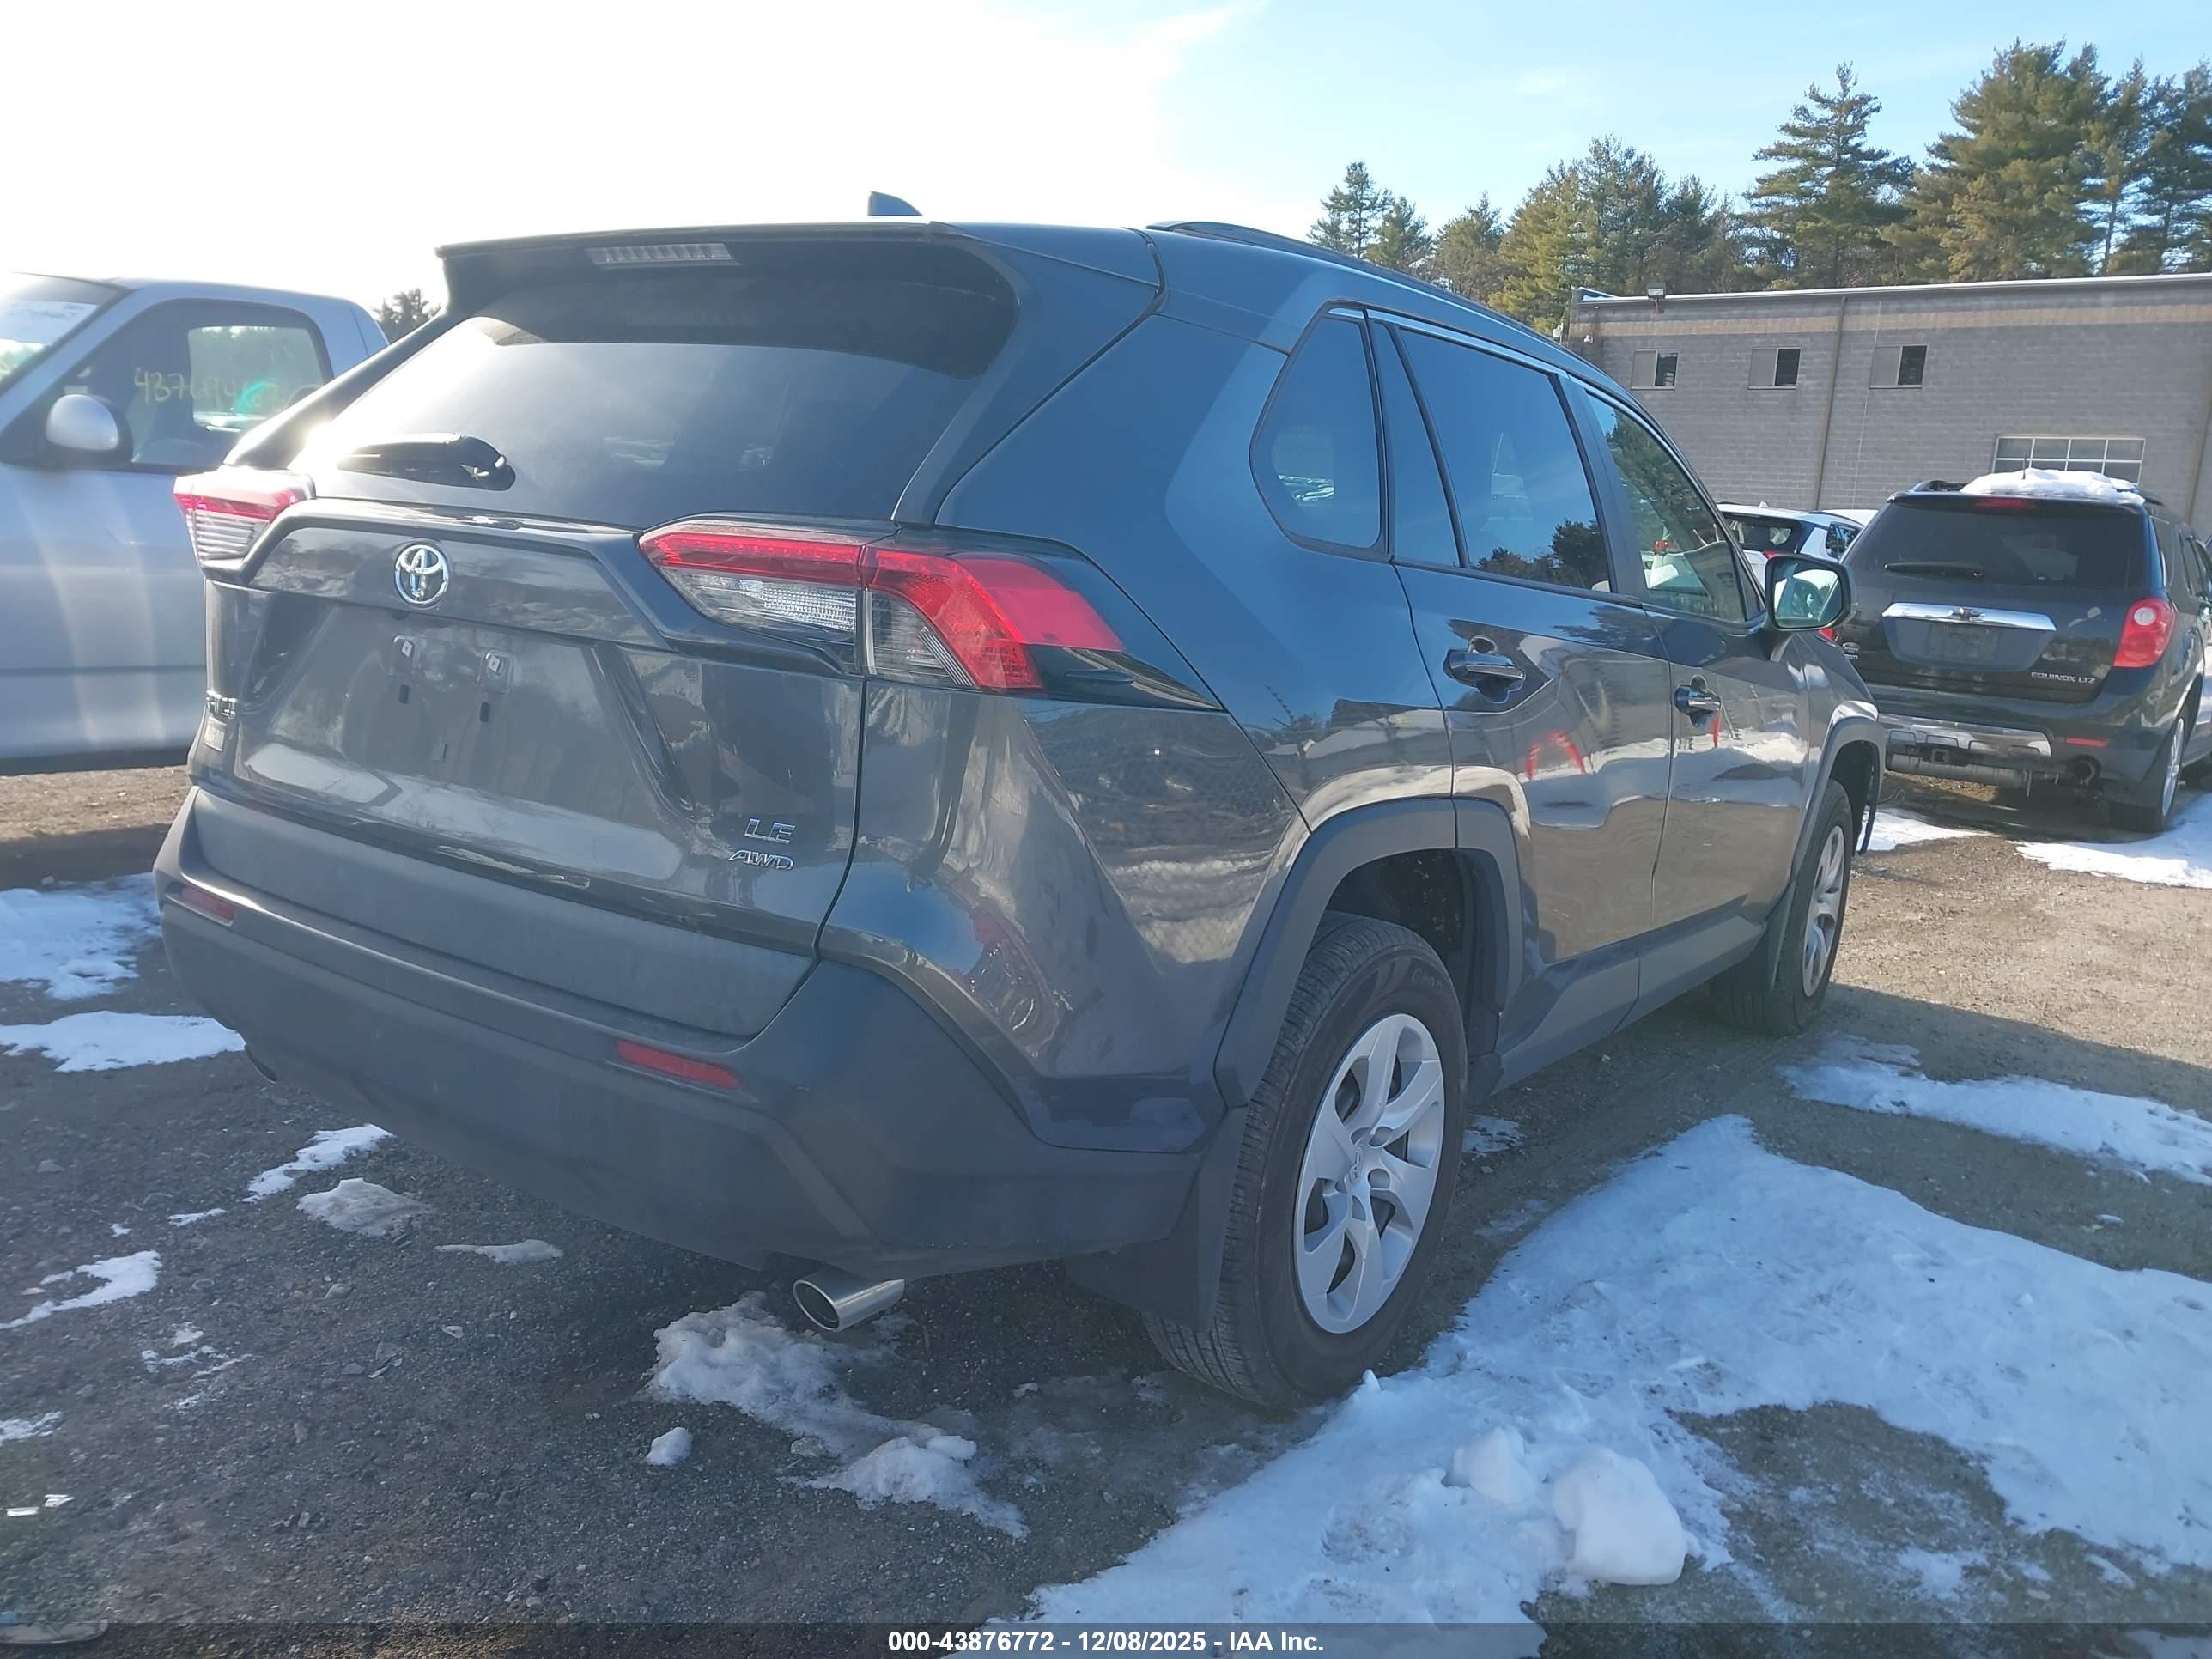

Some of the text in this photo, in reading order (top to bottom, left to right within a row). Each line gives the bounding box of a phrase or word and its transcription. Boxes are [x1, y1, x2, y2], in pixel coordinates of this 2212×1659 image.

[2031, 672, 2076, 682] EQUINOX
[744, 818, 796, 845] LE
[728, 849, 795, 871] AWD
